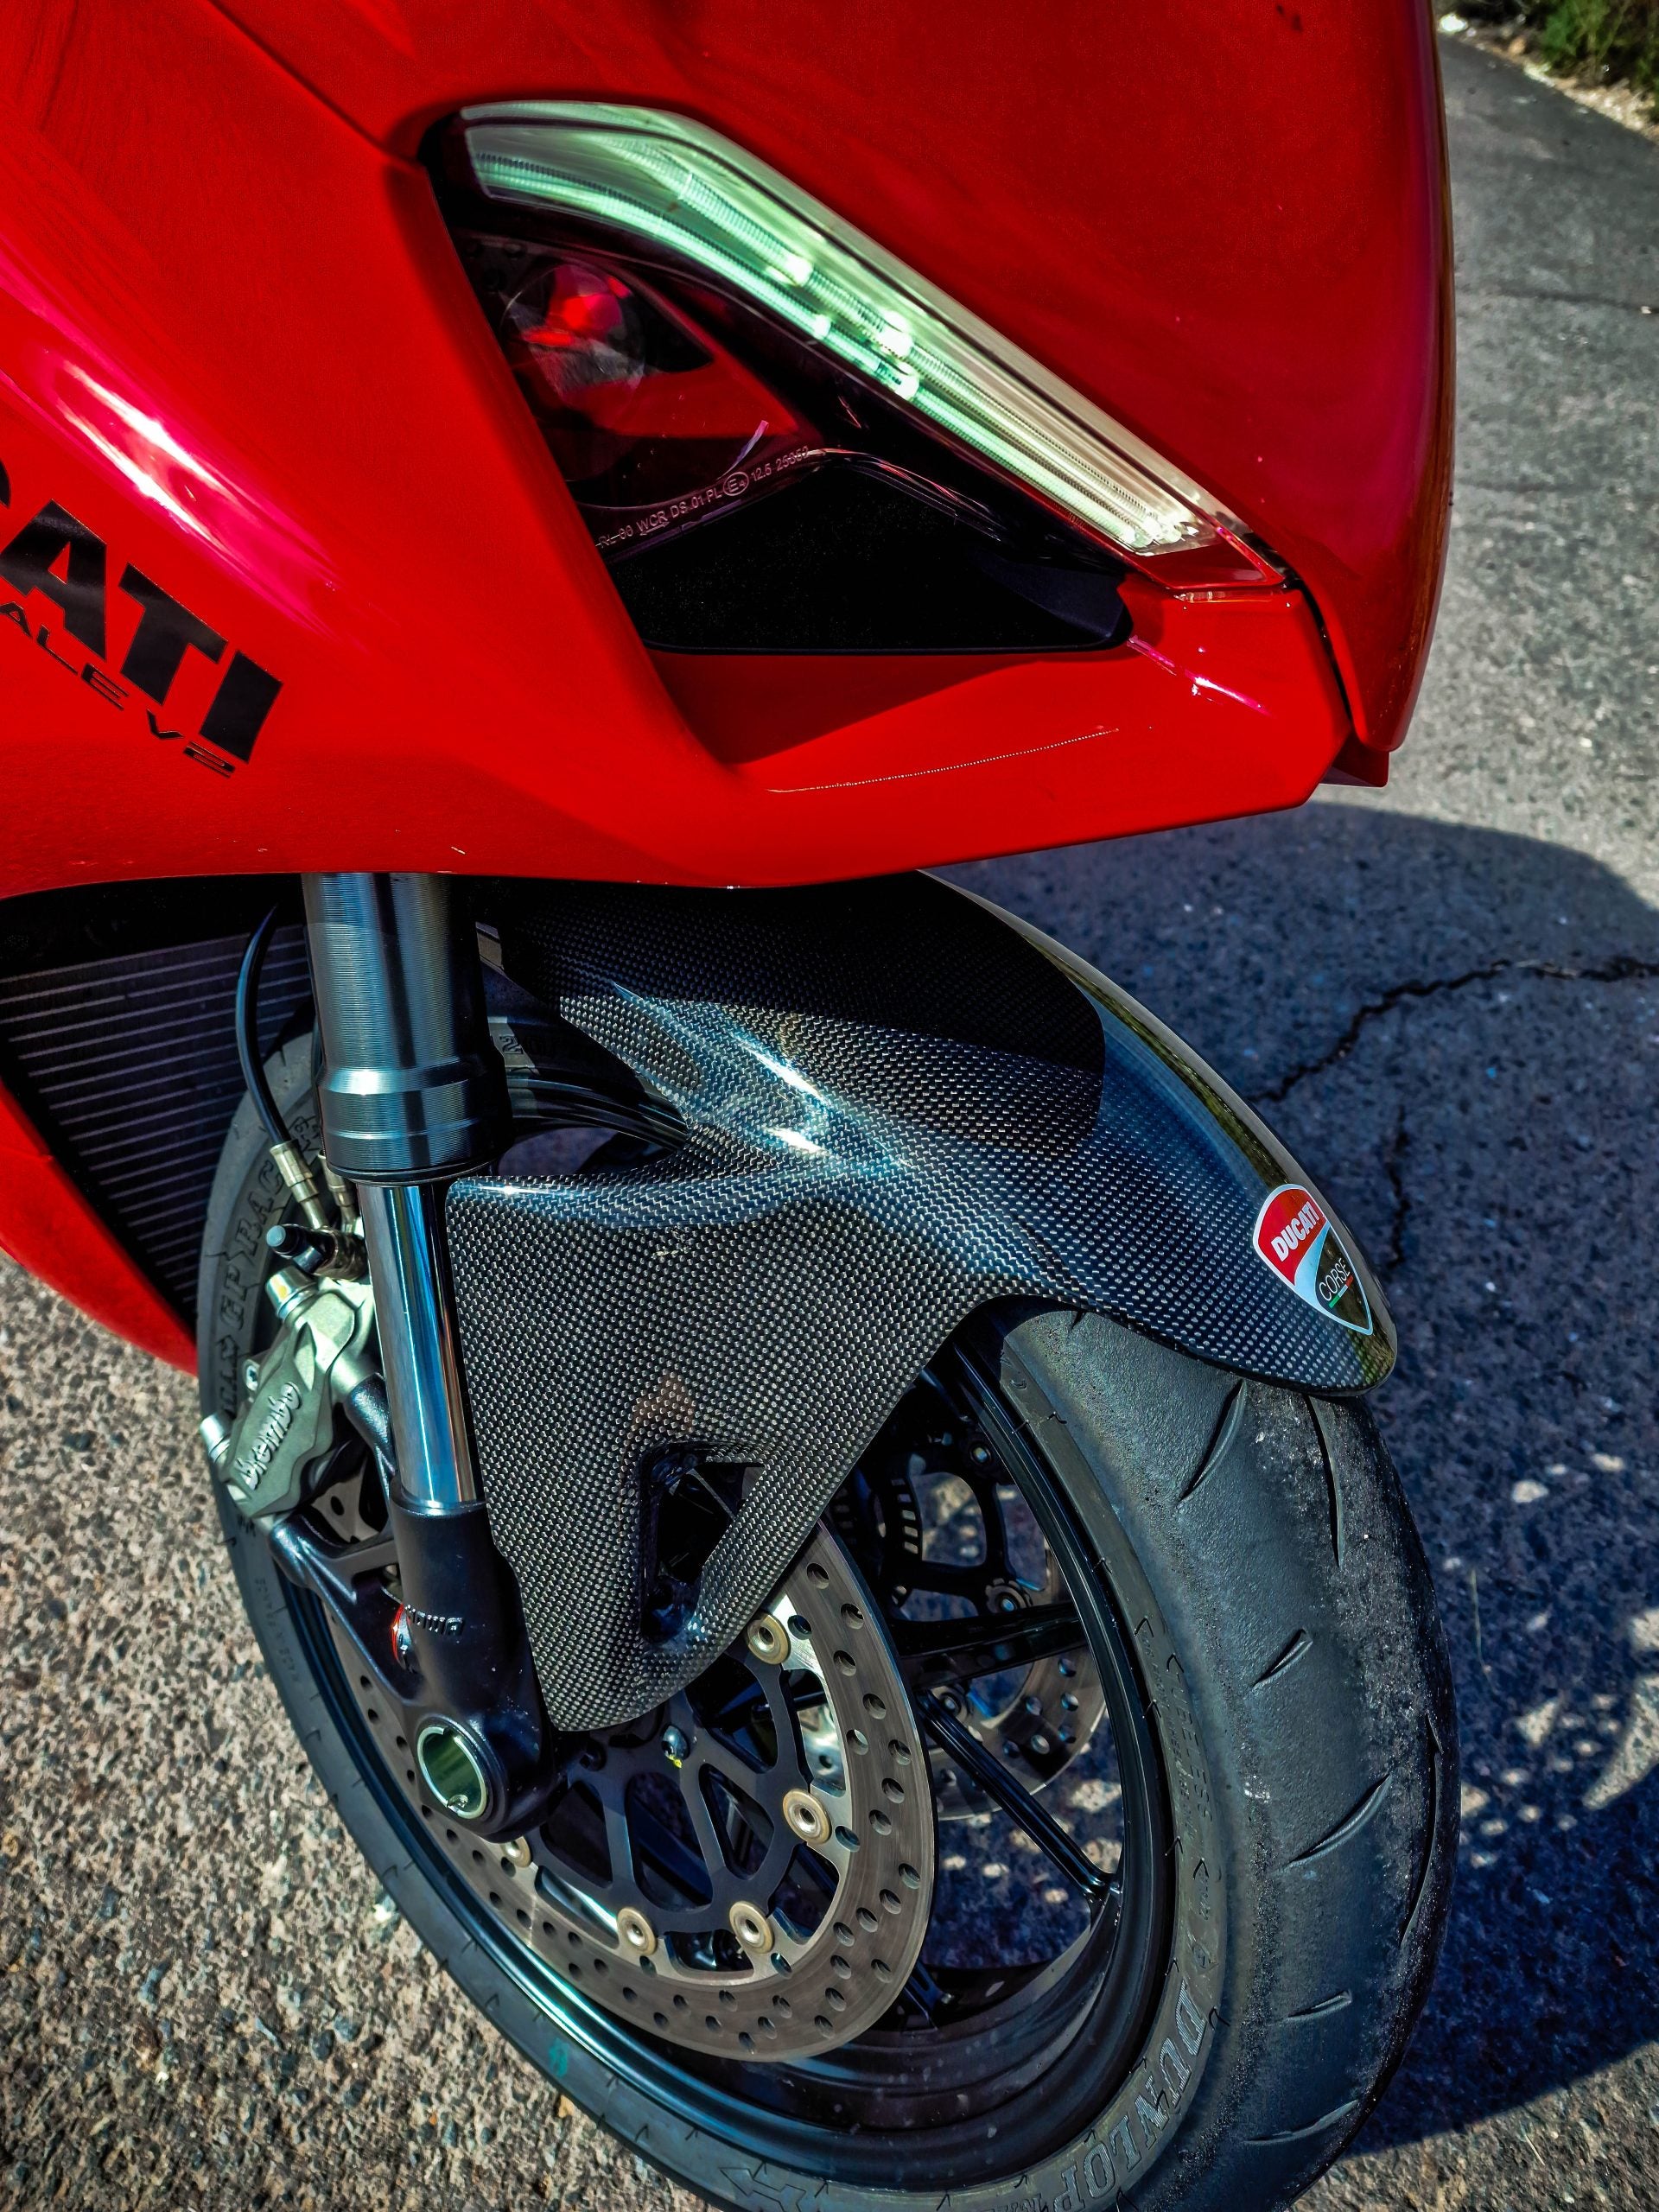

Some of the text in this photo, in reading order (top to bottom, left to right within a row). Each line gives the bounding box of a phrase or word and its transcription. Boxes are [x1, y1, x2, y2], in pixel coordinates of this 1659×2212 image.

[636, 511, 668, 533] WCR
[706, 486, 723, 503] PL
[751, 462, 772, 482] 12.5
[0, 460, 283, 764] ATI
[1270, 1200, 1320, 1262] DUCATI
[1319, 1257, 1351, 1302] CORSE
[233, 1381, 302, 1491] brembo
[1052, 1978, 1208, 2212] DUNLOP
